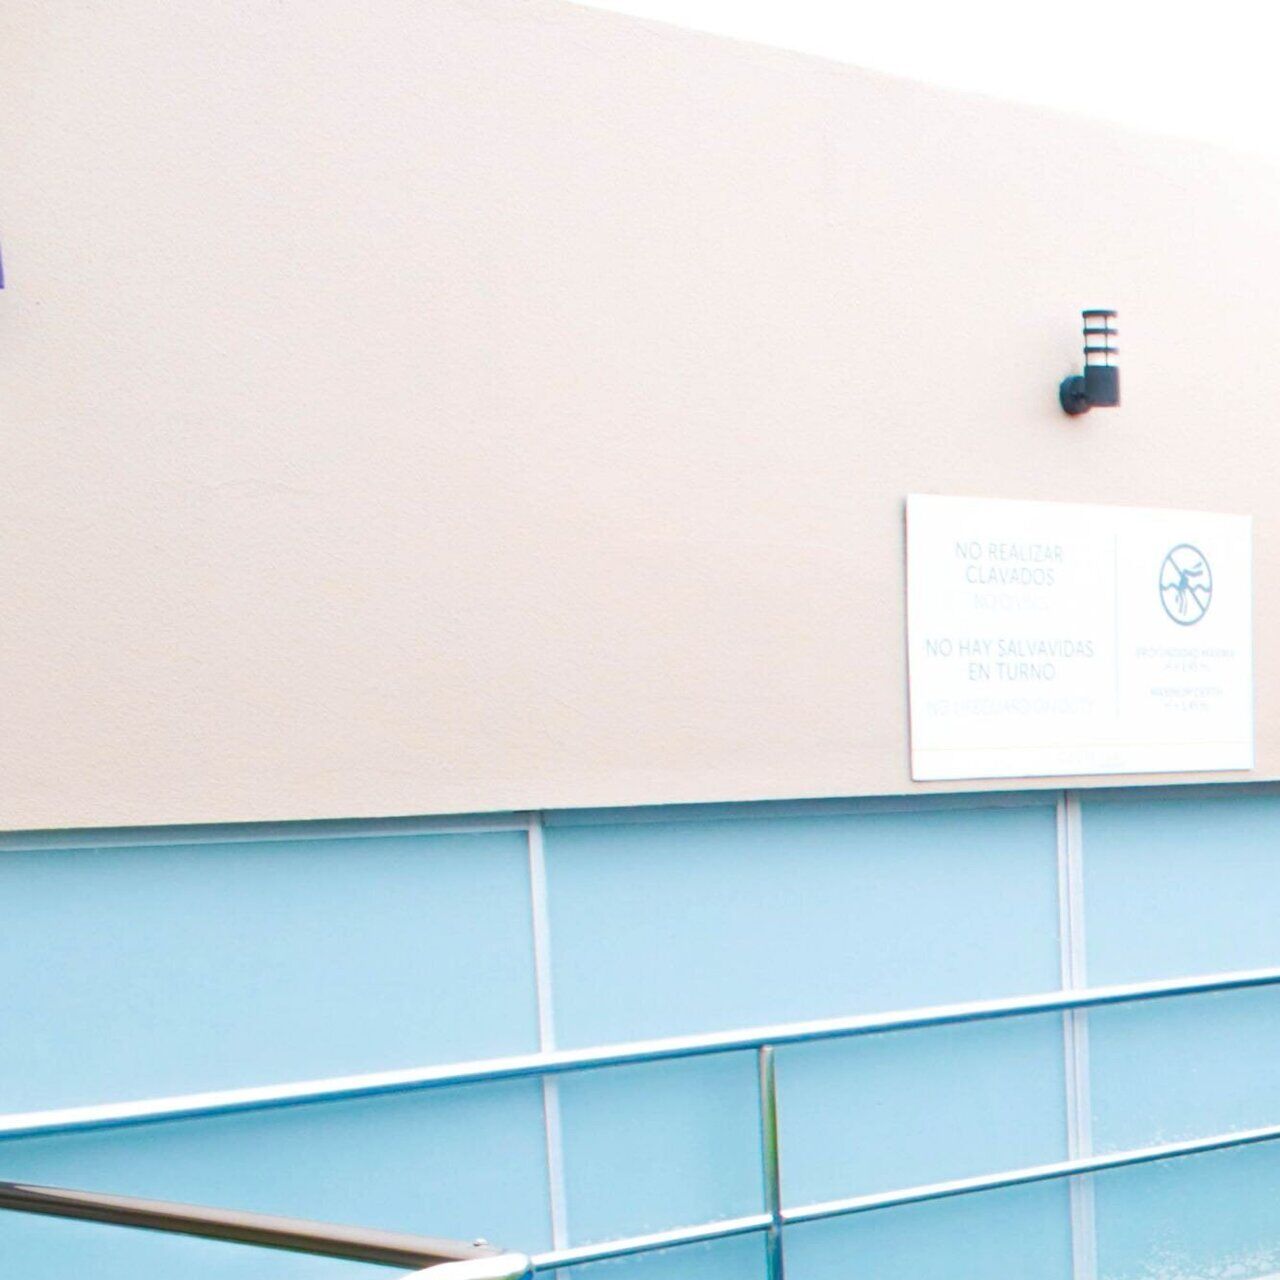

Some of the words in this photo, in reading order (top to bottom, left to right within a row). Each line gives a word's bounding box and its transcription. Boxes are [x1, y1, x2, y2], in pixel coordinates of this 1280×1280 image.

[954, 541, 983, 560] NO
[987, 542, 1064, 563] REALIZAR
[965, 565, 1055, 586] CLAVADOS
[925, 638, 953, 657] NO
[958, 639, 992, 657] HAY
[997, 639, 1095, 658] SALVAVIDAS
[968, 662, 990, 681] EN
[995, 662, 1057, 681] TURNO
